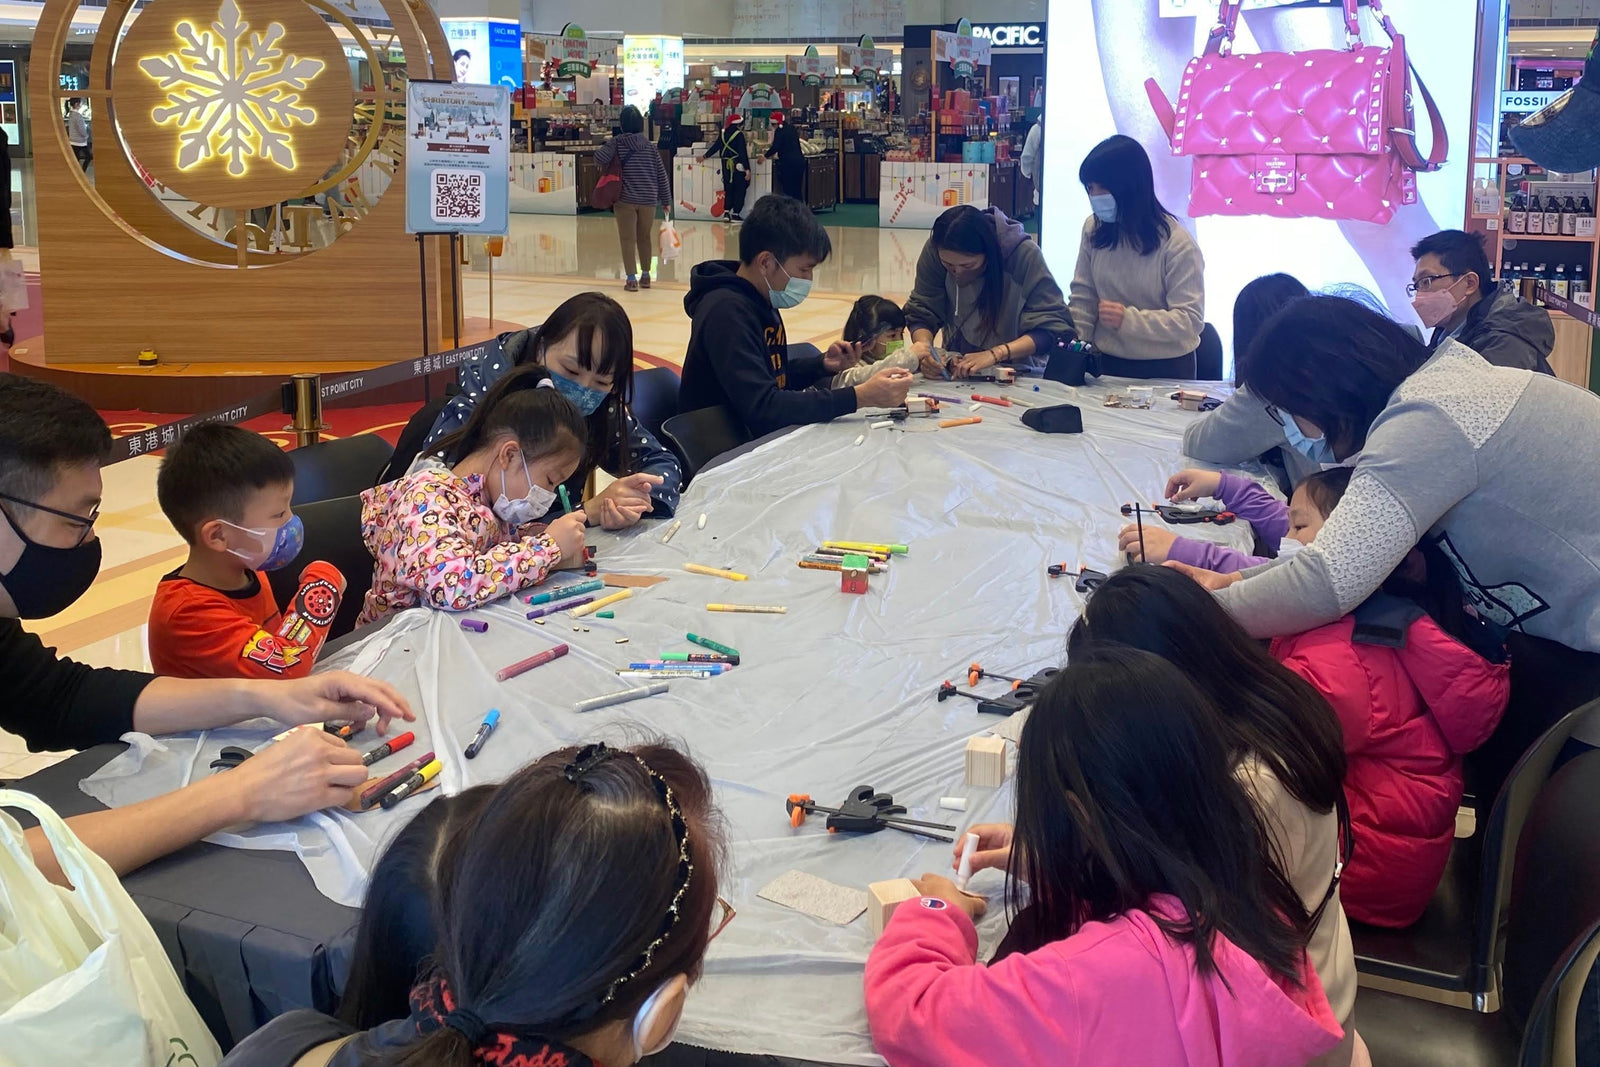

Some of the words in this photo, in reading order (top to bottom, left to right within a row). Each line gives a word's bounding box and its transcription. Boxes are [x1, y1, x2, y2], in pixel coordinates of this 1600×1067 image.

[413, 355, 442, 375] 東港城
[445, 354, 459, 366] EAST
[459, 350, 474, 362] POINT
[321, 385, 330, 398] ST
[330, 381, 349, 395] POINT
[350, 377, 364, 390] CITY
[230, 405, 248, 420] CITY
[128, 425, 175, 456] 東港城
